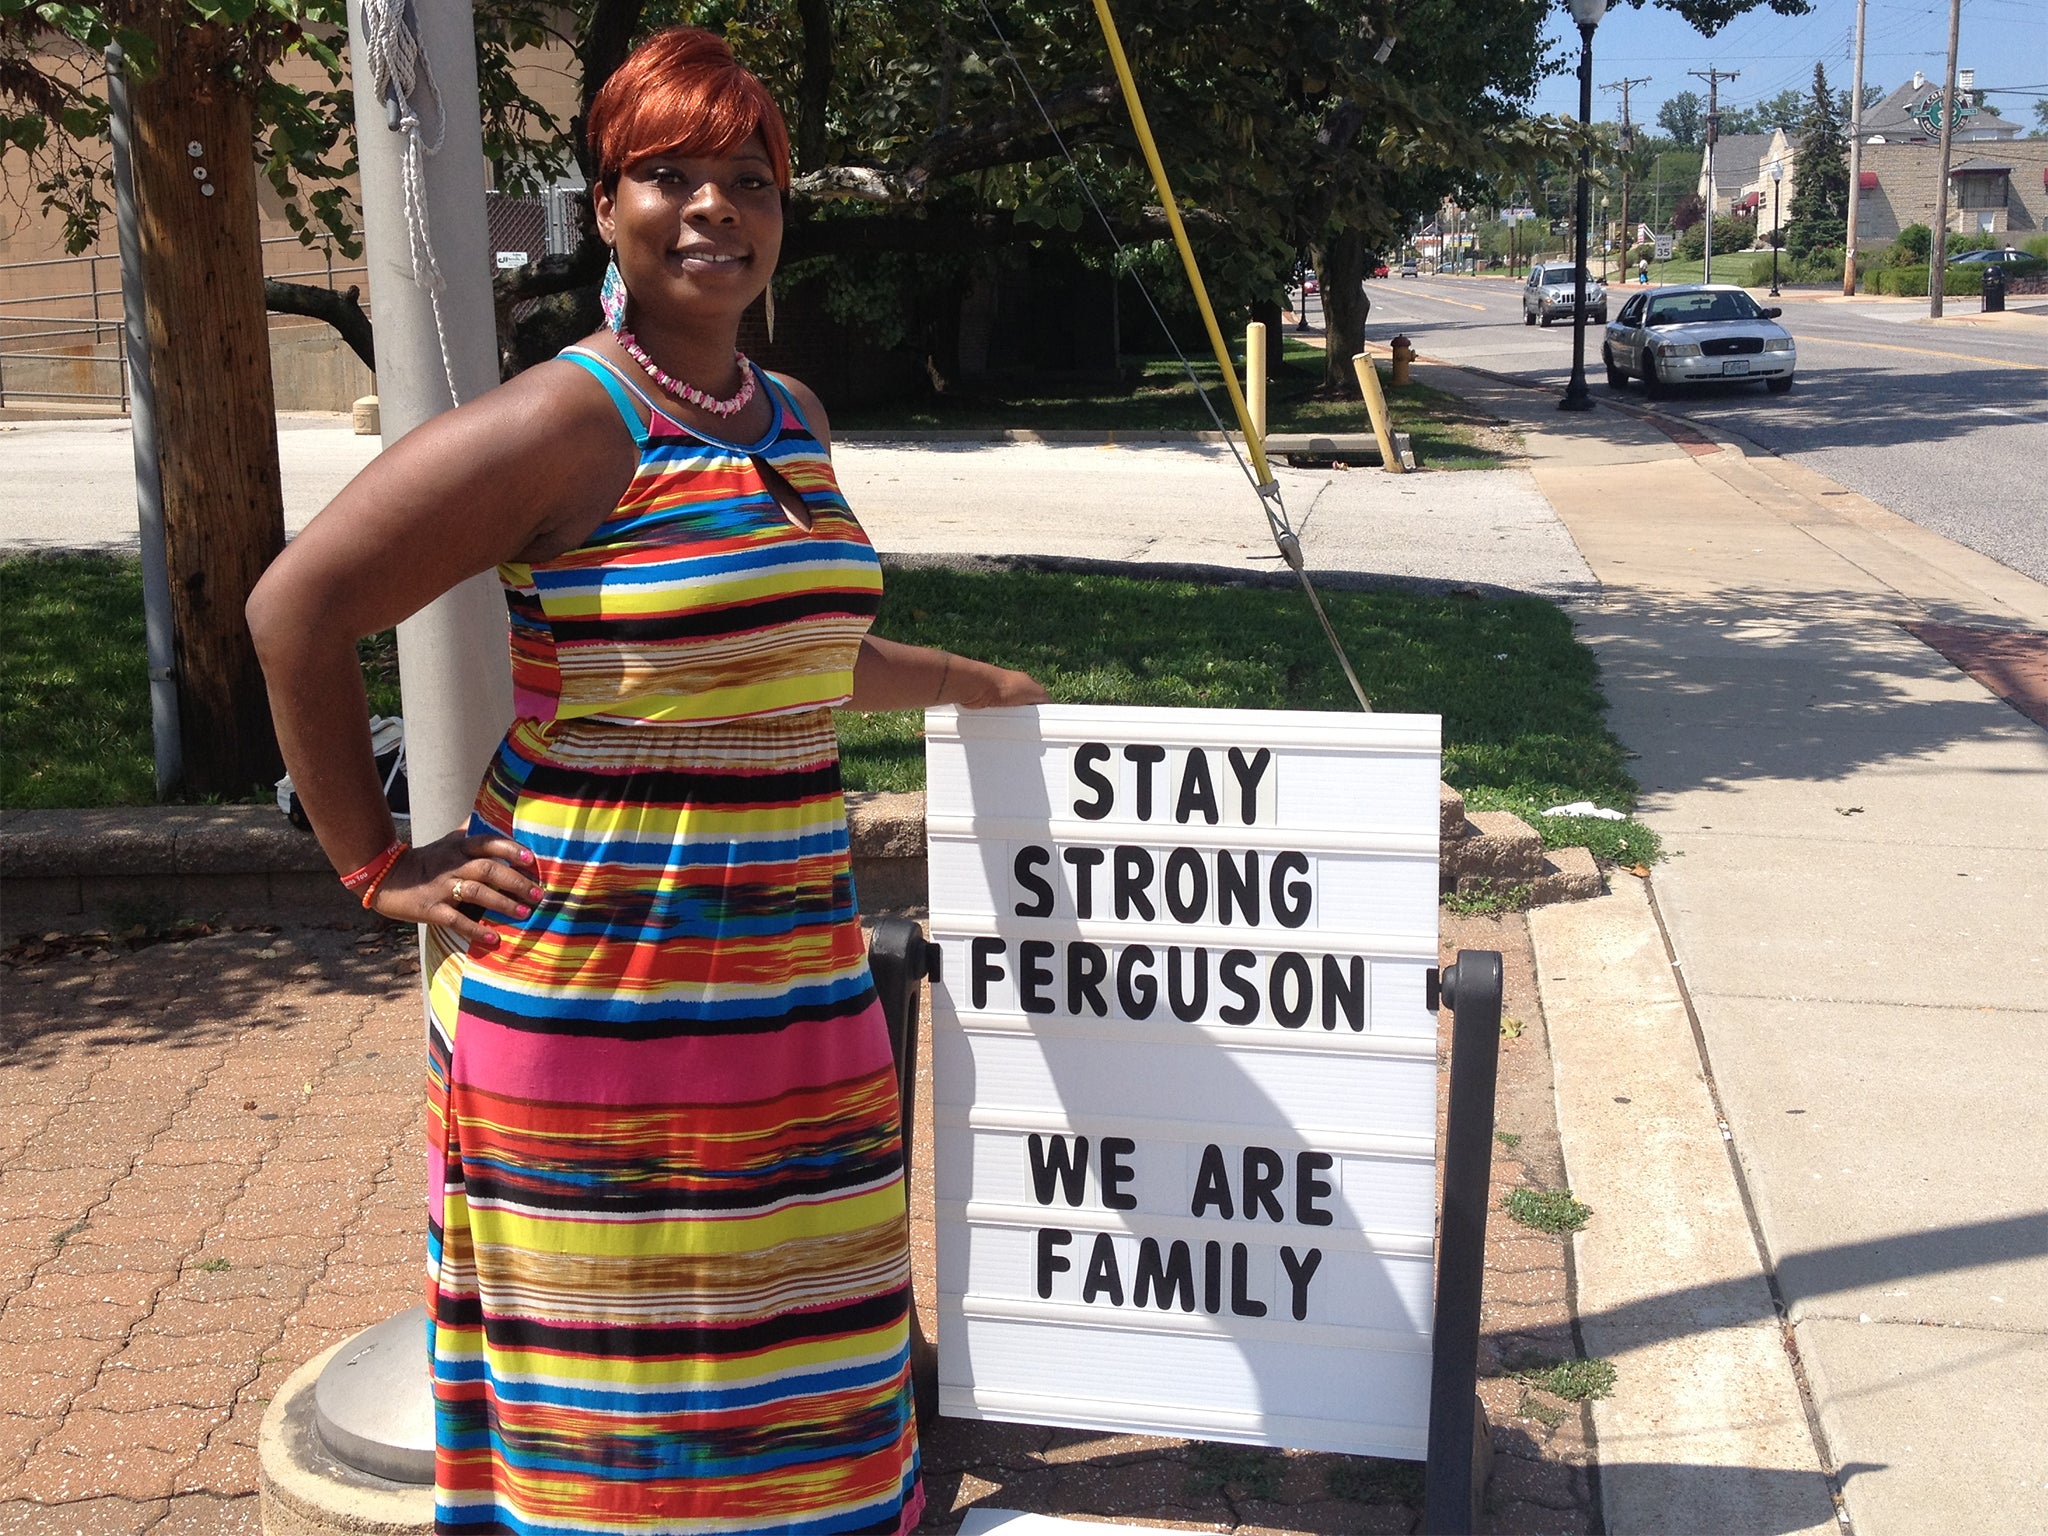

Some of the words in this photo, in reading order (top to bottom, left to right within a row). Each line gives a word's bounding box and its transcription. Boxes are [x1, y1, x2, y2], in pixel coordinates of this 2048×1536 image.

[1657, 248, 1670, 257] 35
[1073, 742, 1271, 825] STAY
[1014, 845, 1312, 929] STRONG
[971, 936, 1365, 1032] FERGUSON
[1027, 1133, 1138, 1211] WE
[1191, 1143, 1333, 1227] ARE
[1037, 1227, 1322, 1321] FAMILY
